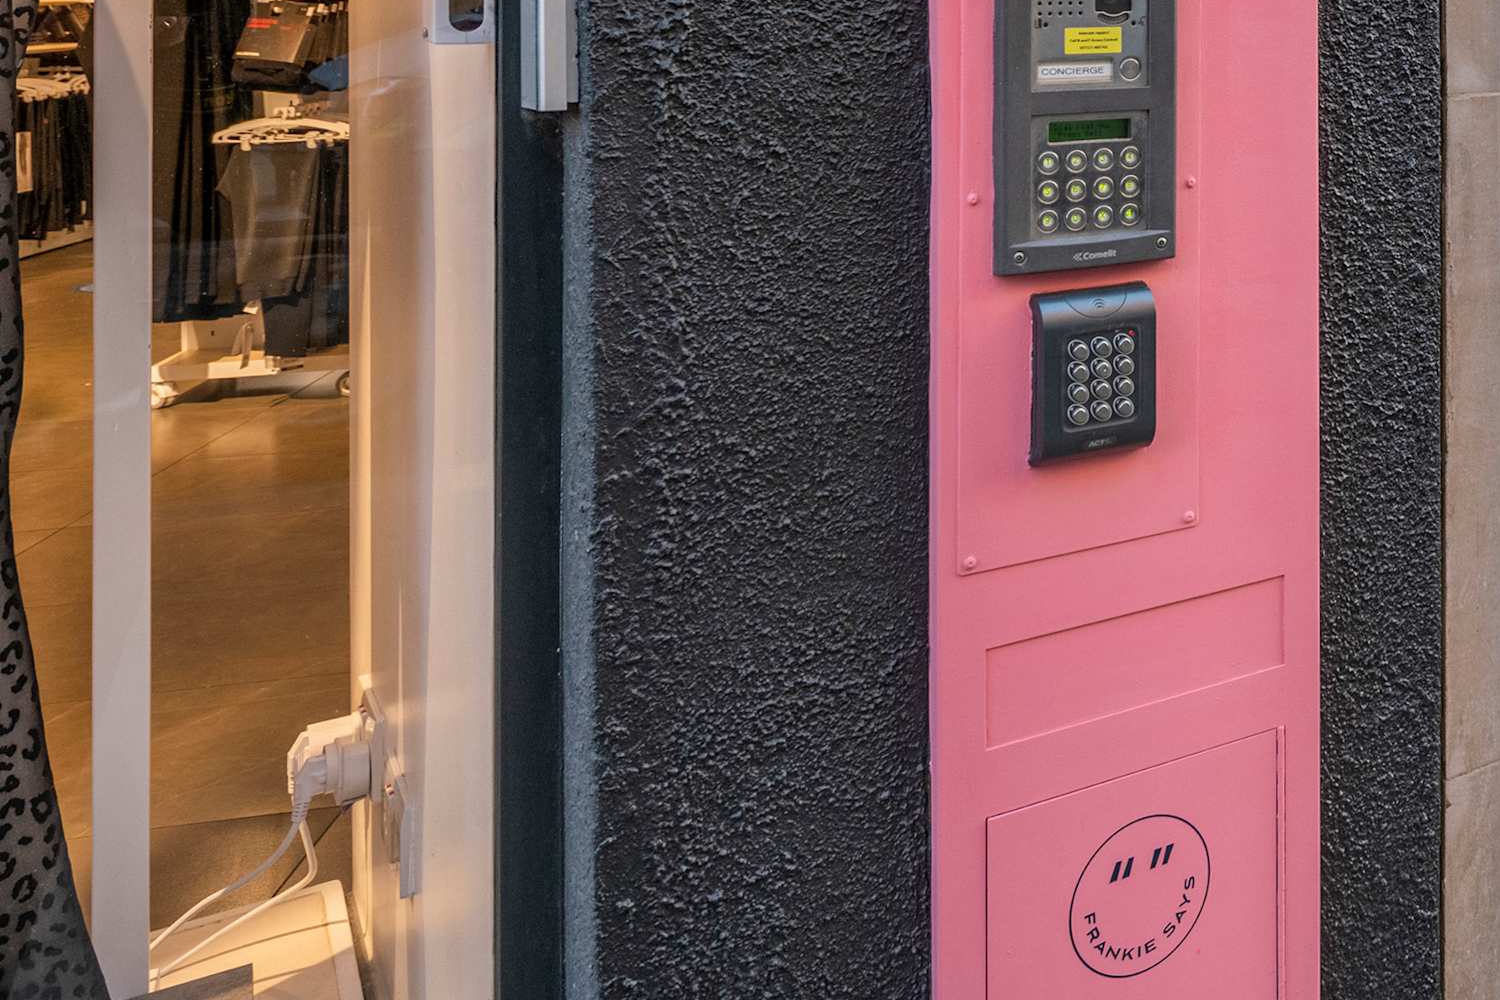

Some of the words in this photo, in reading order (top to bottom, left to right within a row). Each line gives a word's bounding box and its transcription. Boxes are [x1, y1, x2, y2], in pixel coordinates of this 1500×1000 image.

[1041, 66, 1104, 76] CONCIERGE
[1084, 911, 1157, 961] FRANKIE
[1163, 875, 1196, 938] SAYS
